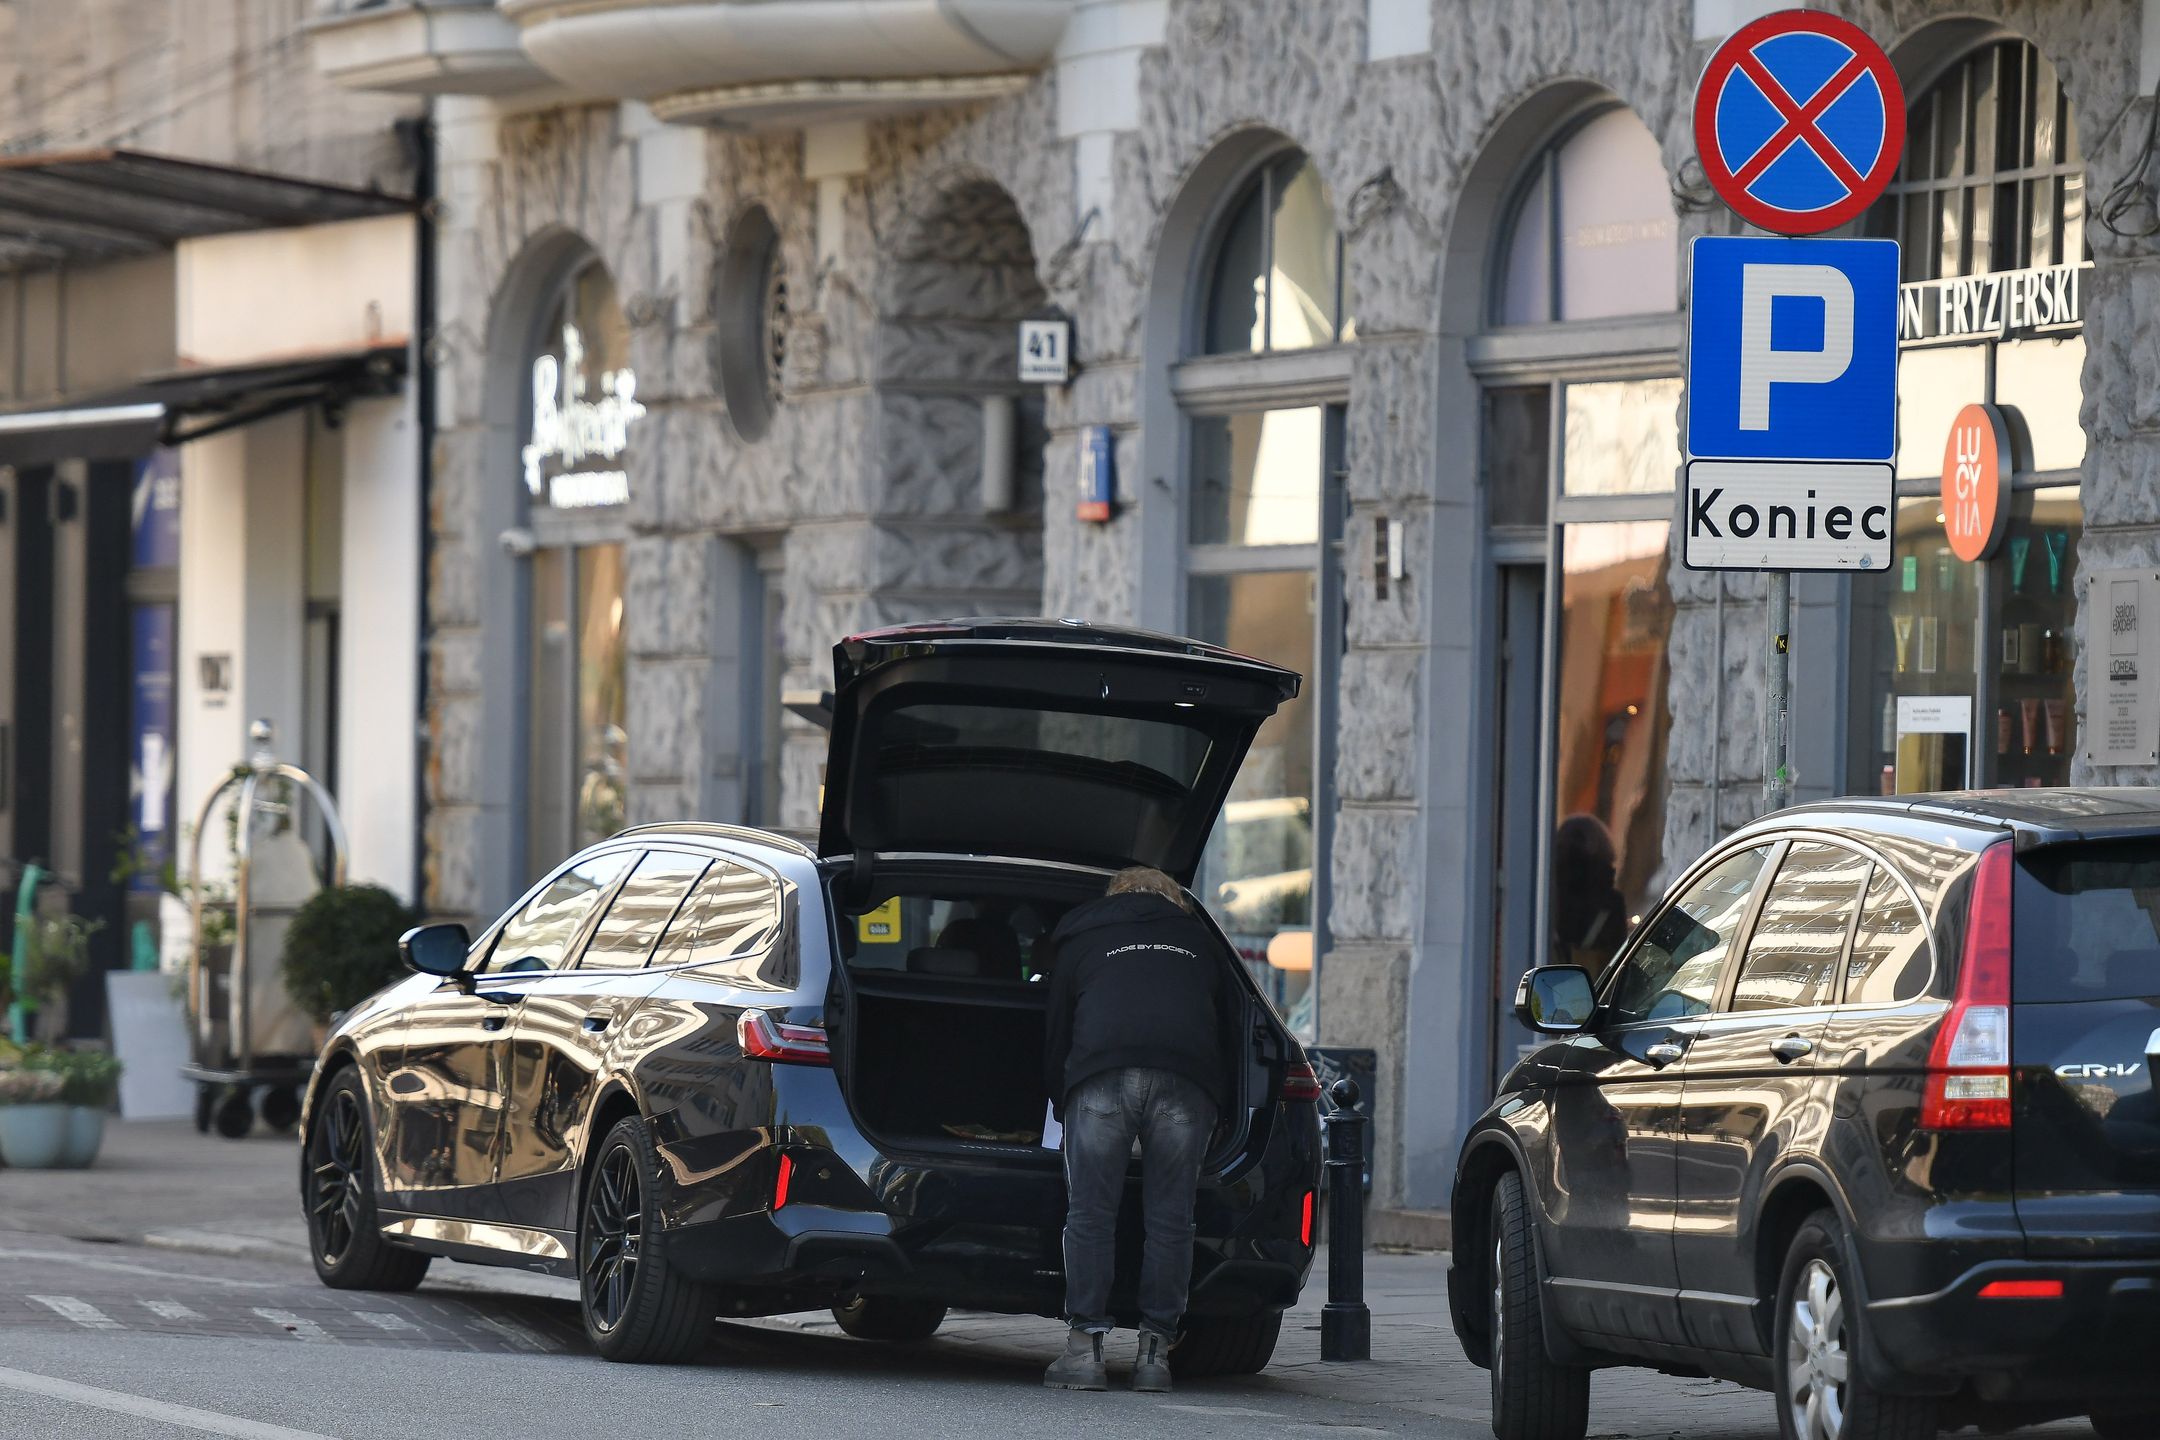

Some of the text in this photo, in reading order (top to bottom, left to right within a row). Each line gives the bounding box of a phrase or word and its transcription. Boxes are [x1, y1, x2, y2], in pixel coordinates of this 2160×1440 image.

[1939, 267, 2079, 339] FRYZJERSKI
[1029, 331, 1057, 359] 41
[1739, 263, 1855, 431] P
[1690, 488, 1888, 540] Koniec
[2115, 601, 2136, 618] salon
[2112, 618, 2137, 636] expert
[1106, 944, 1136, 957] MADE
[1153, 944, 1197, 958] SOCIETY
[2054, 1063, 2142, 1078] CR-V
